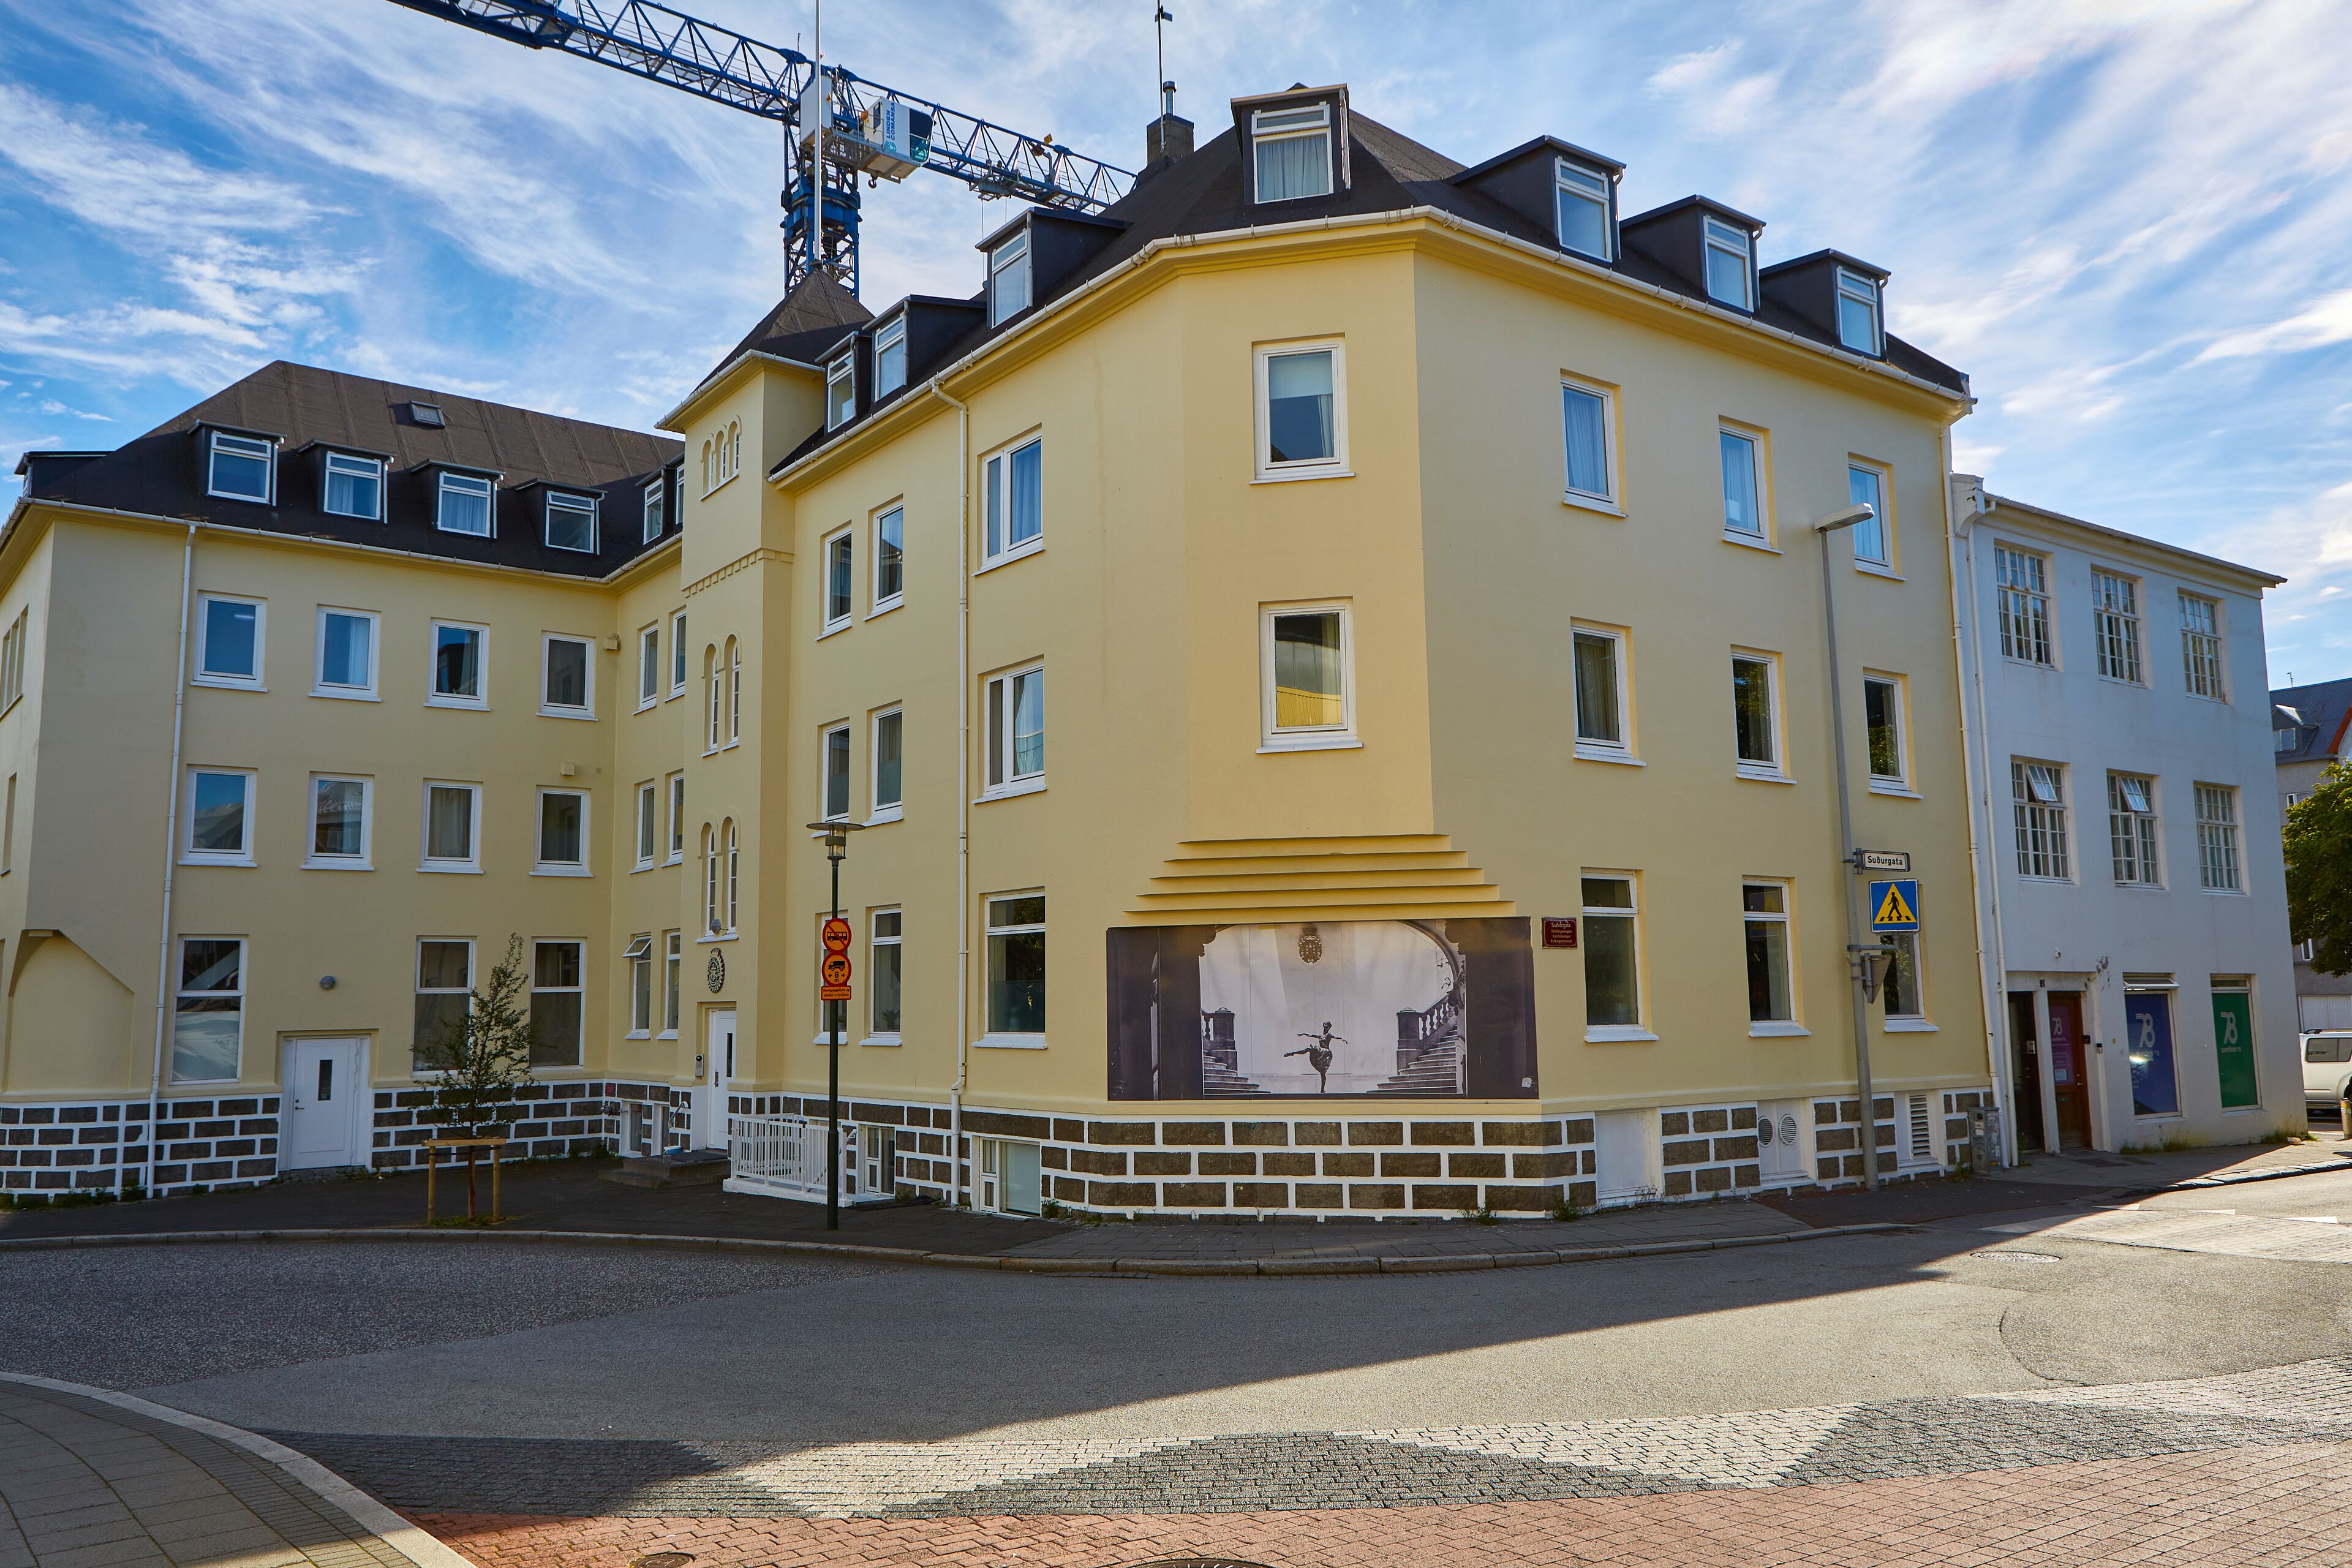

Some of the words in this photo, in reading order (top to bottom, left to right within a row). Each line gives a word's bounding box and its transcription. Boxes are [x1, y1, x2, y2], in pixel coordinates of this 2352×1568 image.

[1868, 856, 1903, 865] Suðurgata
[2051, 1017, 2063, 1036] 78
[2135, 1012, 2156, 1048] 78
[2220, 1011, 2238, 1044] 78
